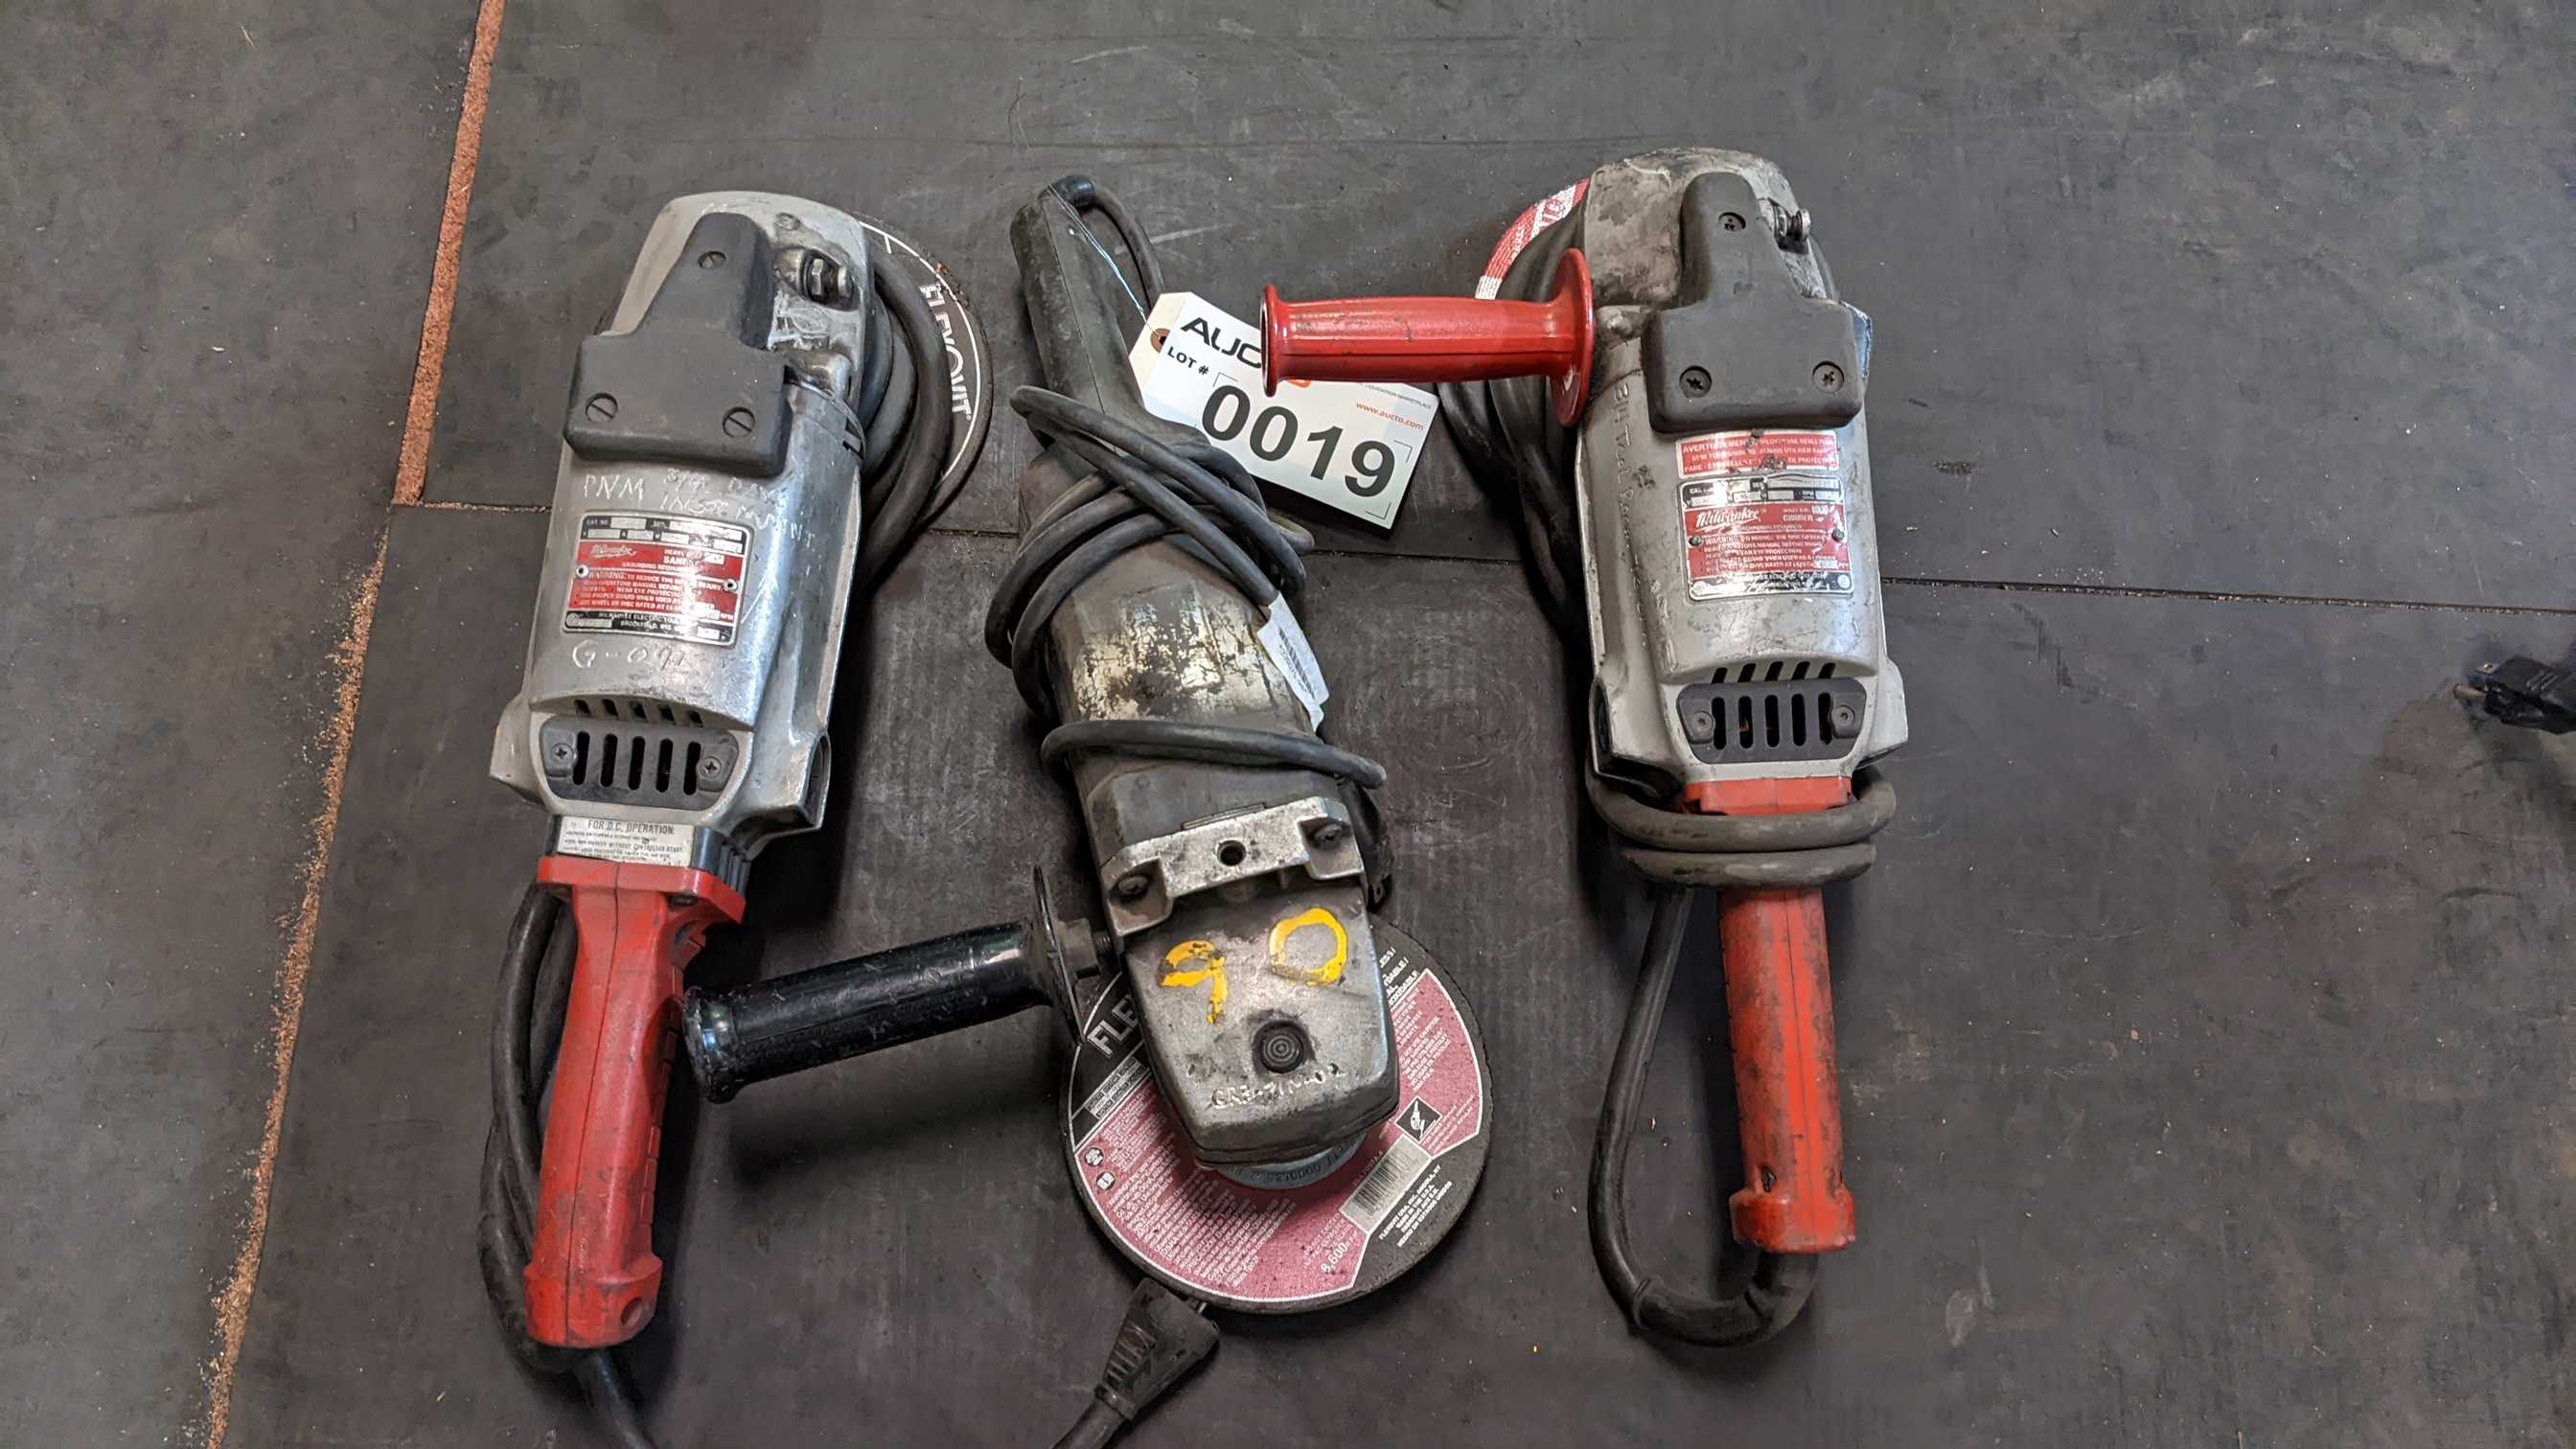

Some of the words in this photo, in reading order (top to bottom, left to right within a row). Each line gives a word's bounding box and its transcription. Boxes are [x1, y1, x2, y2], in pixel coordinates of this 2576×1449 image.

[1180, 317, 1262, 369] AUC
[1167, 346, 1196, 369] LOT
[1199, 364, 1209, 376] #
[1356, 402, 1423, 430] www.aucto.com
[1202, 385, 1395, 497] 0019
[584, 474, 644, 500] PNM
[1695, 508, 1761, 528] Milwaukee
[587, 819, 604, 829] FOR
[627, 822, 674, 835] OPERATION
[1412, 1197, 1423, 1208] THE
[1411, 1220, 1420, 1230] EN
[1319, 1241, 1351, 1276] 8,600
